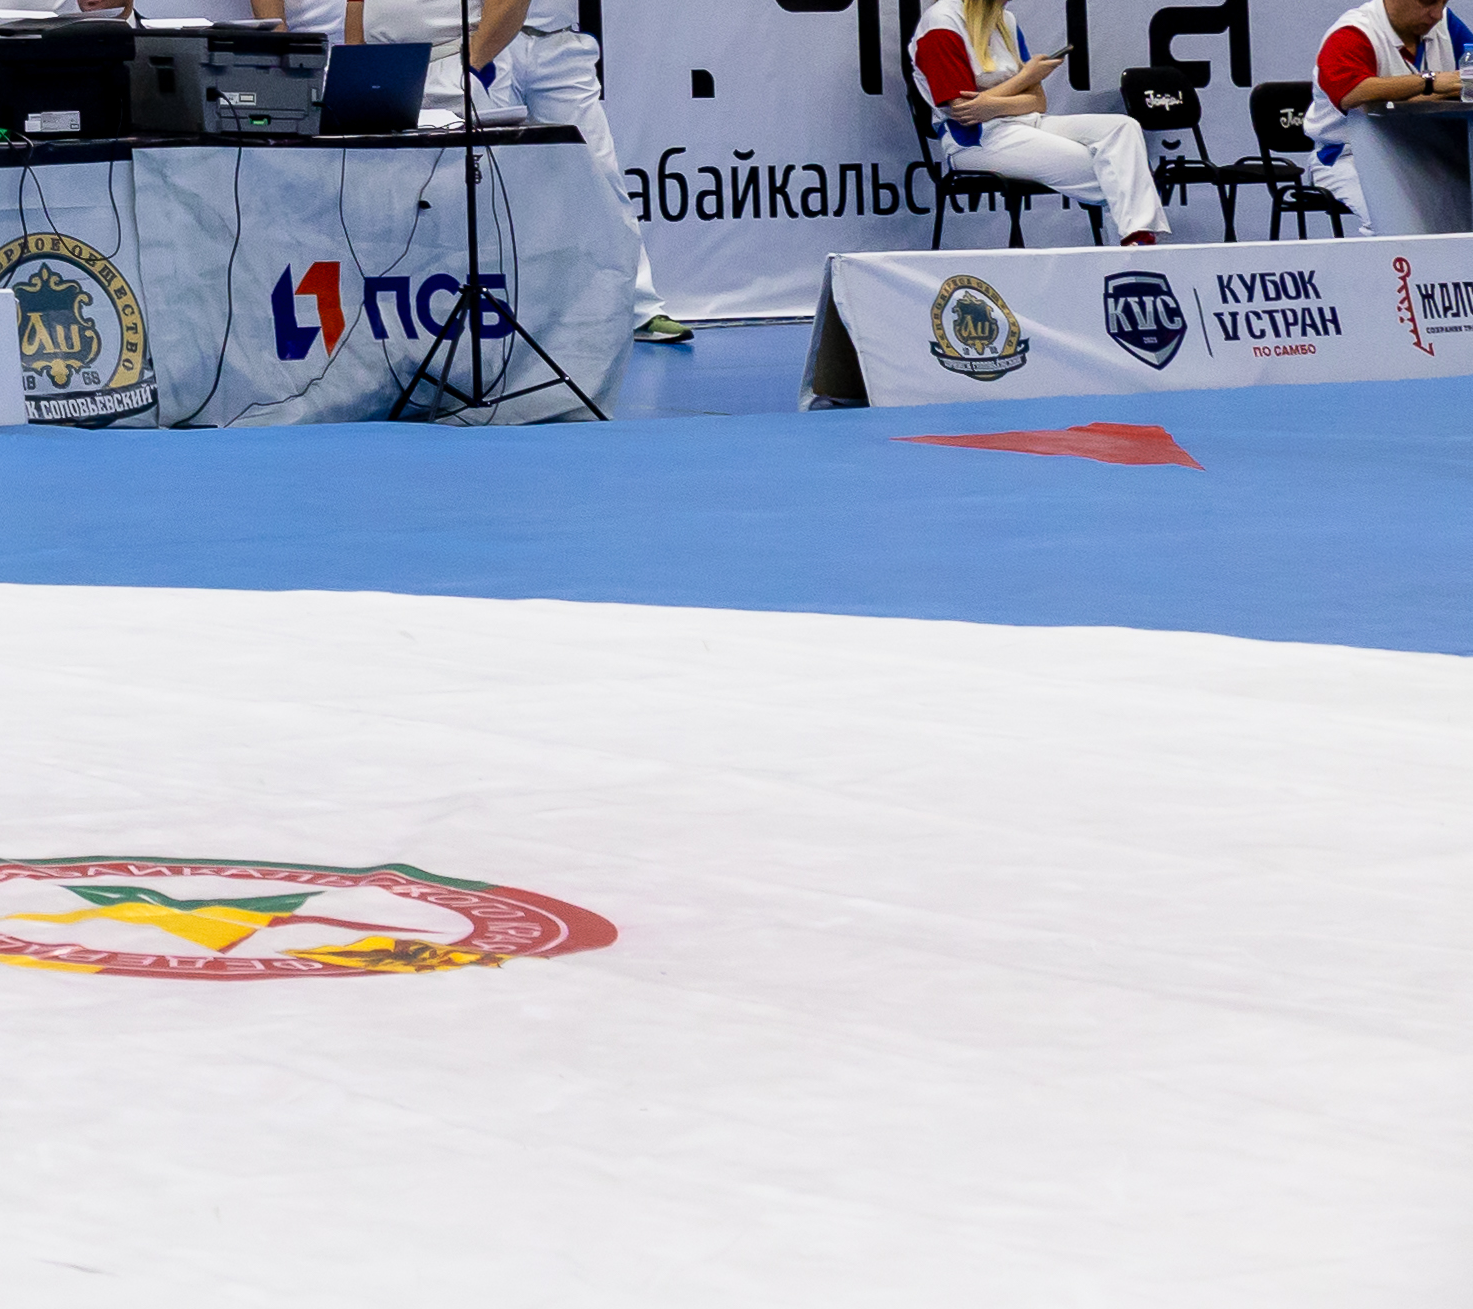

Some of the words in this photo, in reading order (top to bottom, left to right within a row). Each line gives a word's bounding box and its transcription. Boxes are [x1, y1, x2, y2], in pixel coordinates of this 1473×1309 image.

[1216, 270, 1321, 304] КУБОК
[1415, 282, 1473, 319] ЖАЛС
[364, 273, 517, 340] ПСБ
[1107, 295, 1182, 333] KVC
[1245, 306, 1342, 338] СТРАН
[1252, 346, 1271, 358] ПО
[1273, 343, 1316, 357] САМБО
[470, 922, 544, 953] КРАЯ
